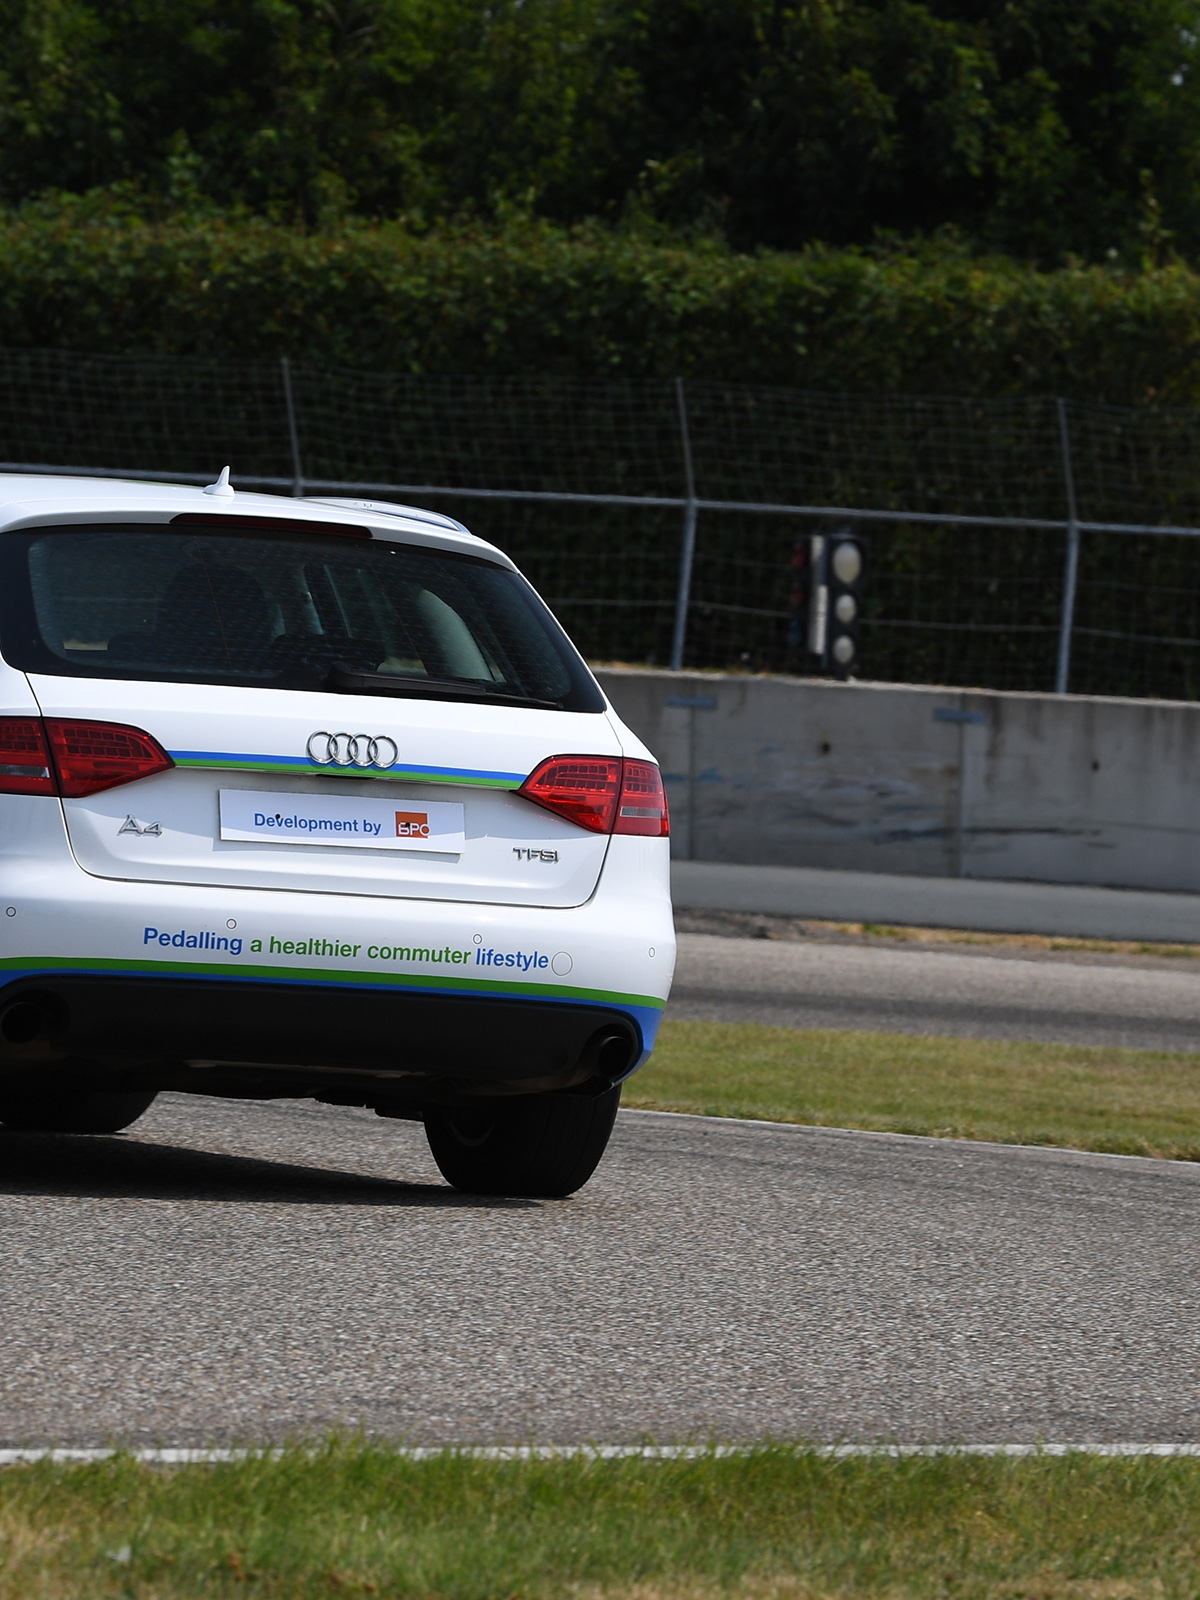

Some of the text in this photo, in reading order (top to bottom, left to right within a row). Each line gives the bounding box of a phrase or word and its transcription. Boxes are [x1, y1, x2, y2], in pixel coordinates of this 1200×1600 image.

[118, 814, 162, 836] A4
[254, 813, 358, 832] Development
[363, 819, 381, 836] by
[512, 847, 559, 863] TFSI
[143, 927, 549, 972] Pedalling a healthier commuter lifestyle
